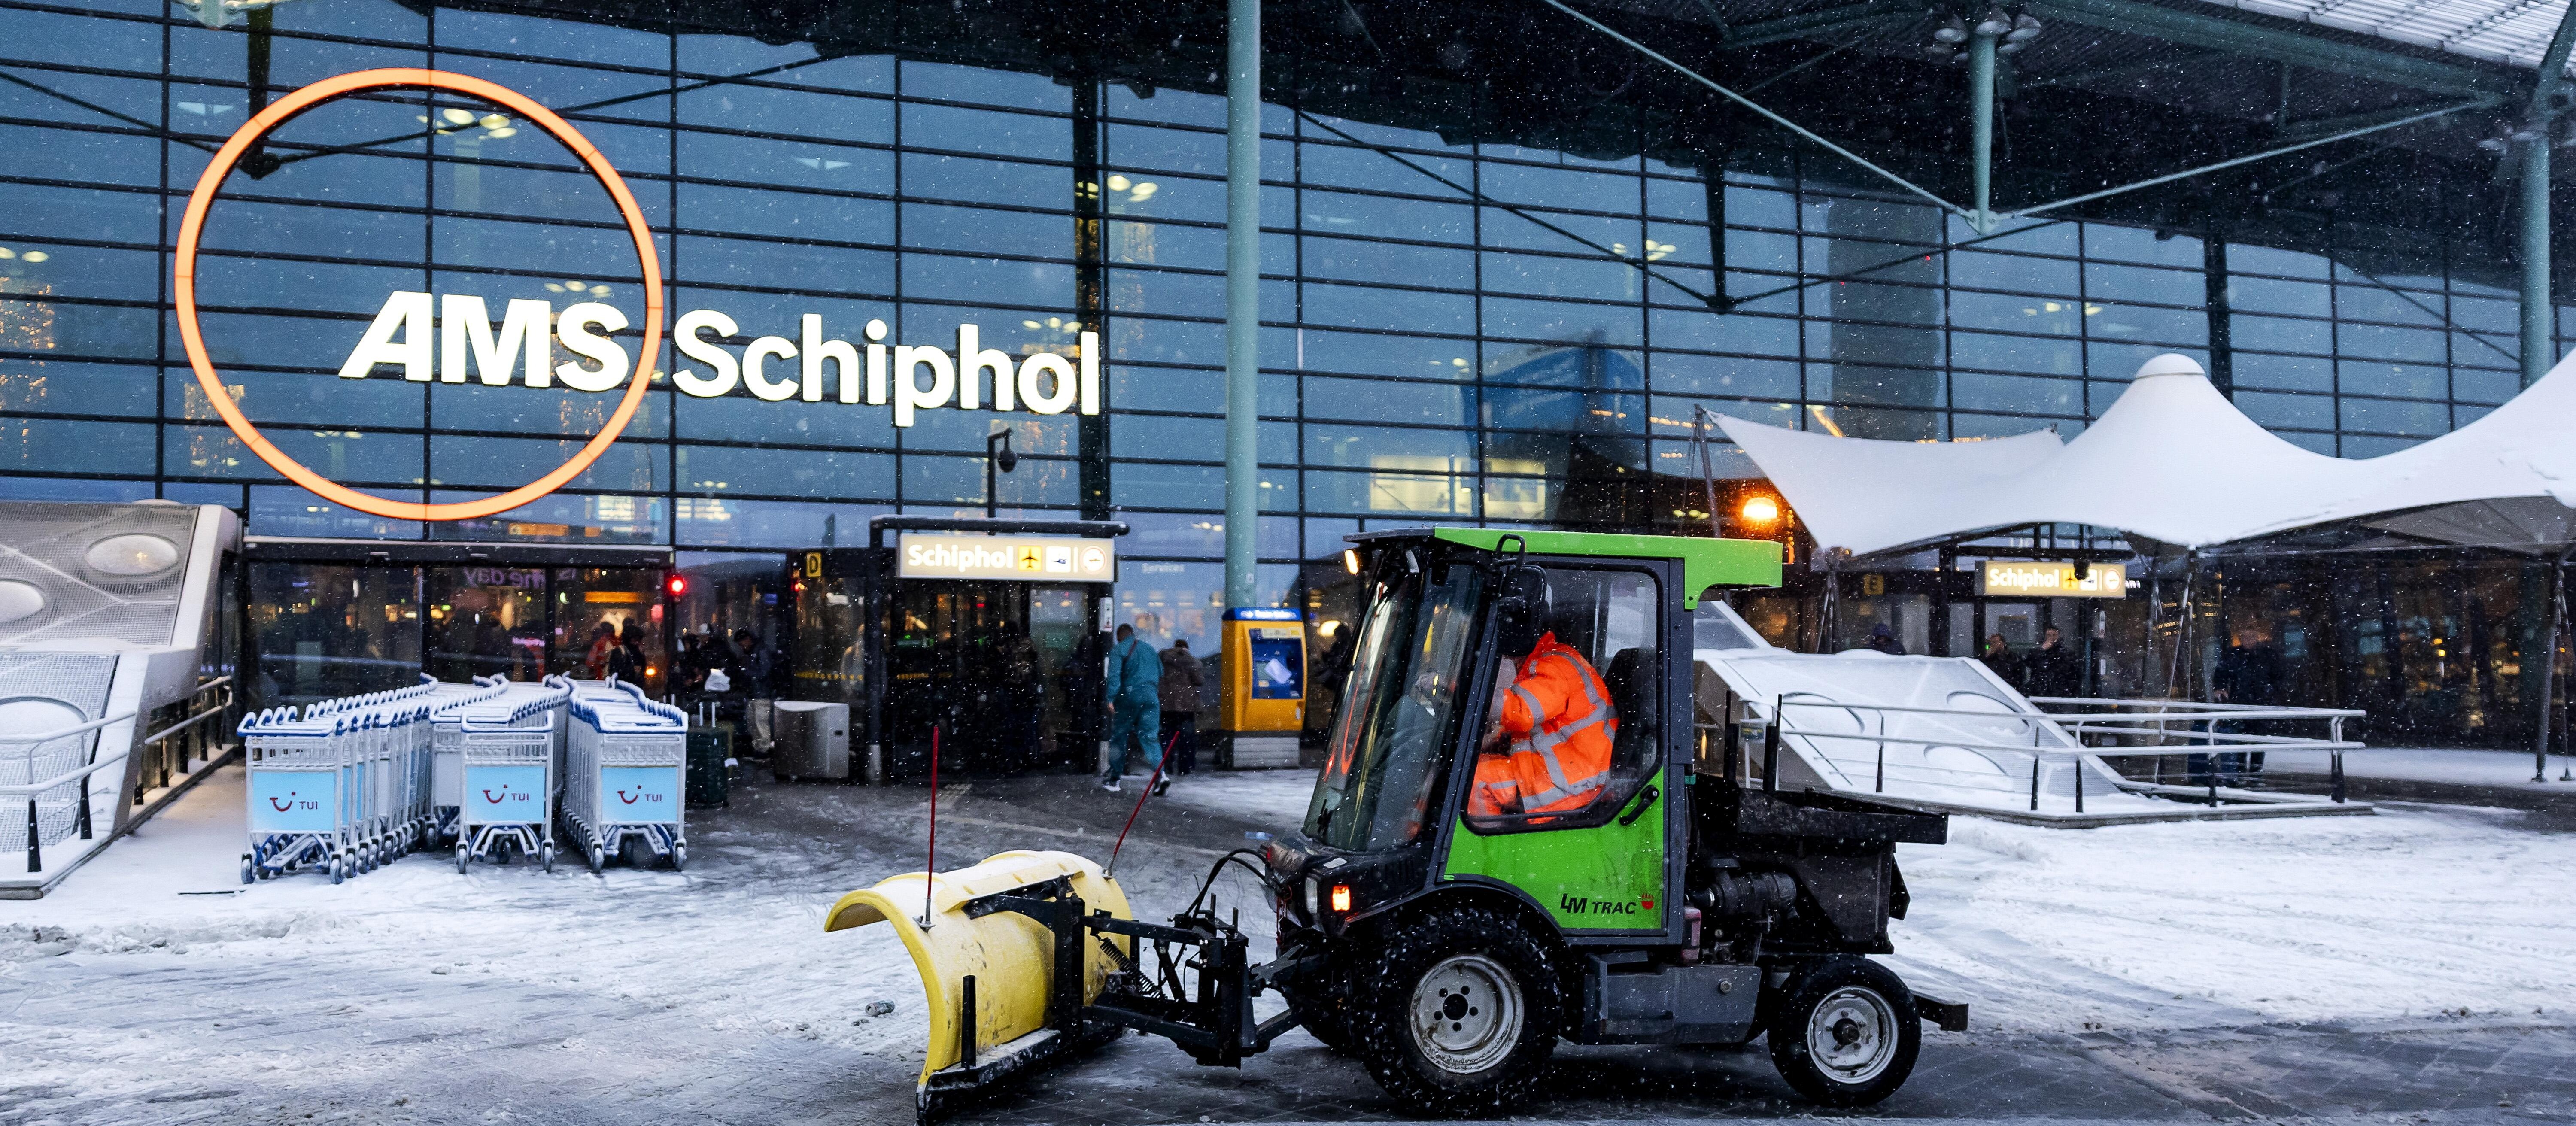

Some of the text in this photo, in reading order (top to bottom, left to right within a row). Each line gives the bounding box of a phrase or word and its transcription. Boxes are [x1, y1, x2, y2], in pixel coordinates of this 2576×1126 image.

[339, 291, 1099, 427] AMS Schiphol
[810, 556, 818, 573] D
[908, 544, 1014, 573] Schiphol
[1989, 568, 2060, 591] Schiphol
[299, 801, 318, 810] TUI
[511, 793, 529, 801] TUI
[646, 794, 662, 802] TUI
[1560, 893, 1637, 914] LM TRAC
